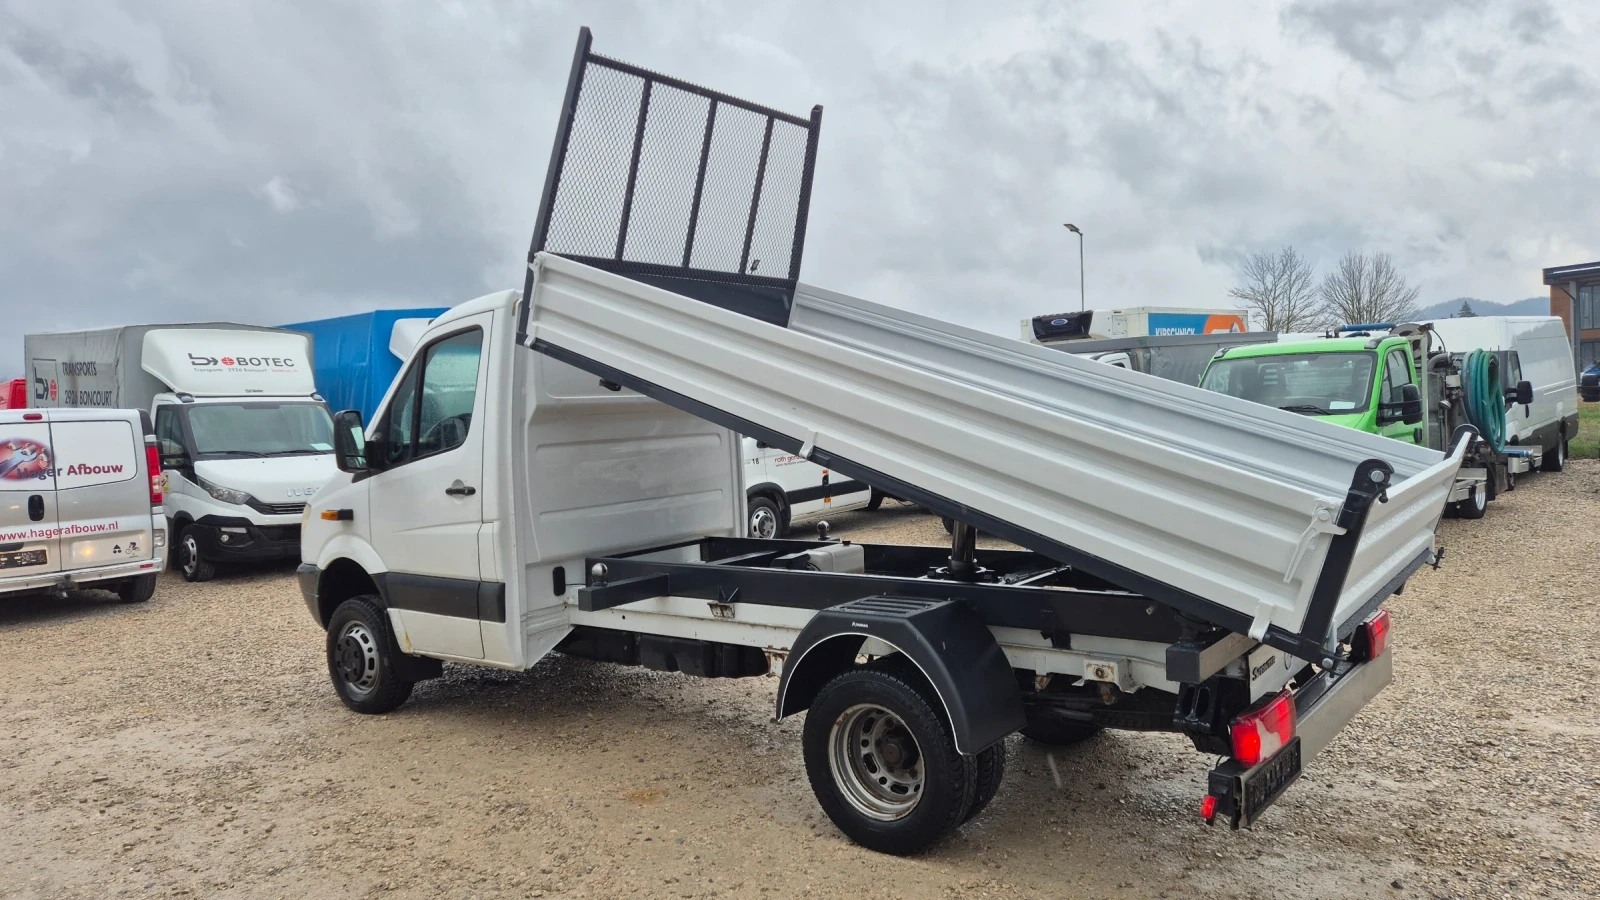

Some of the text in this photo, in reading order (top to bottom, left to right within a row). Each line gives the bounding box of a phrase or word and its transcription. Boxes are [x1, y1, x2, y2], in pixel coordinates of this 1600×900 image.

[61, 361, 98, 377] TRANSPORTS
[236, 356, 295, 367] BOTEC
[64, 389, 112, 406] 2926 BONCOURT
[17, 463, 124, 480] Hager Afbouw
[0, 520, 119, 541] www.hagerafbouw.nl
